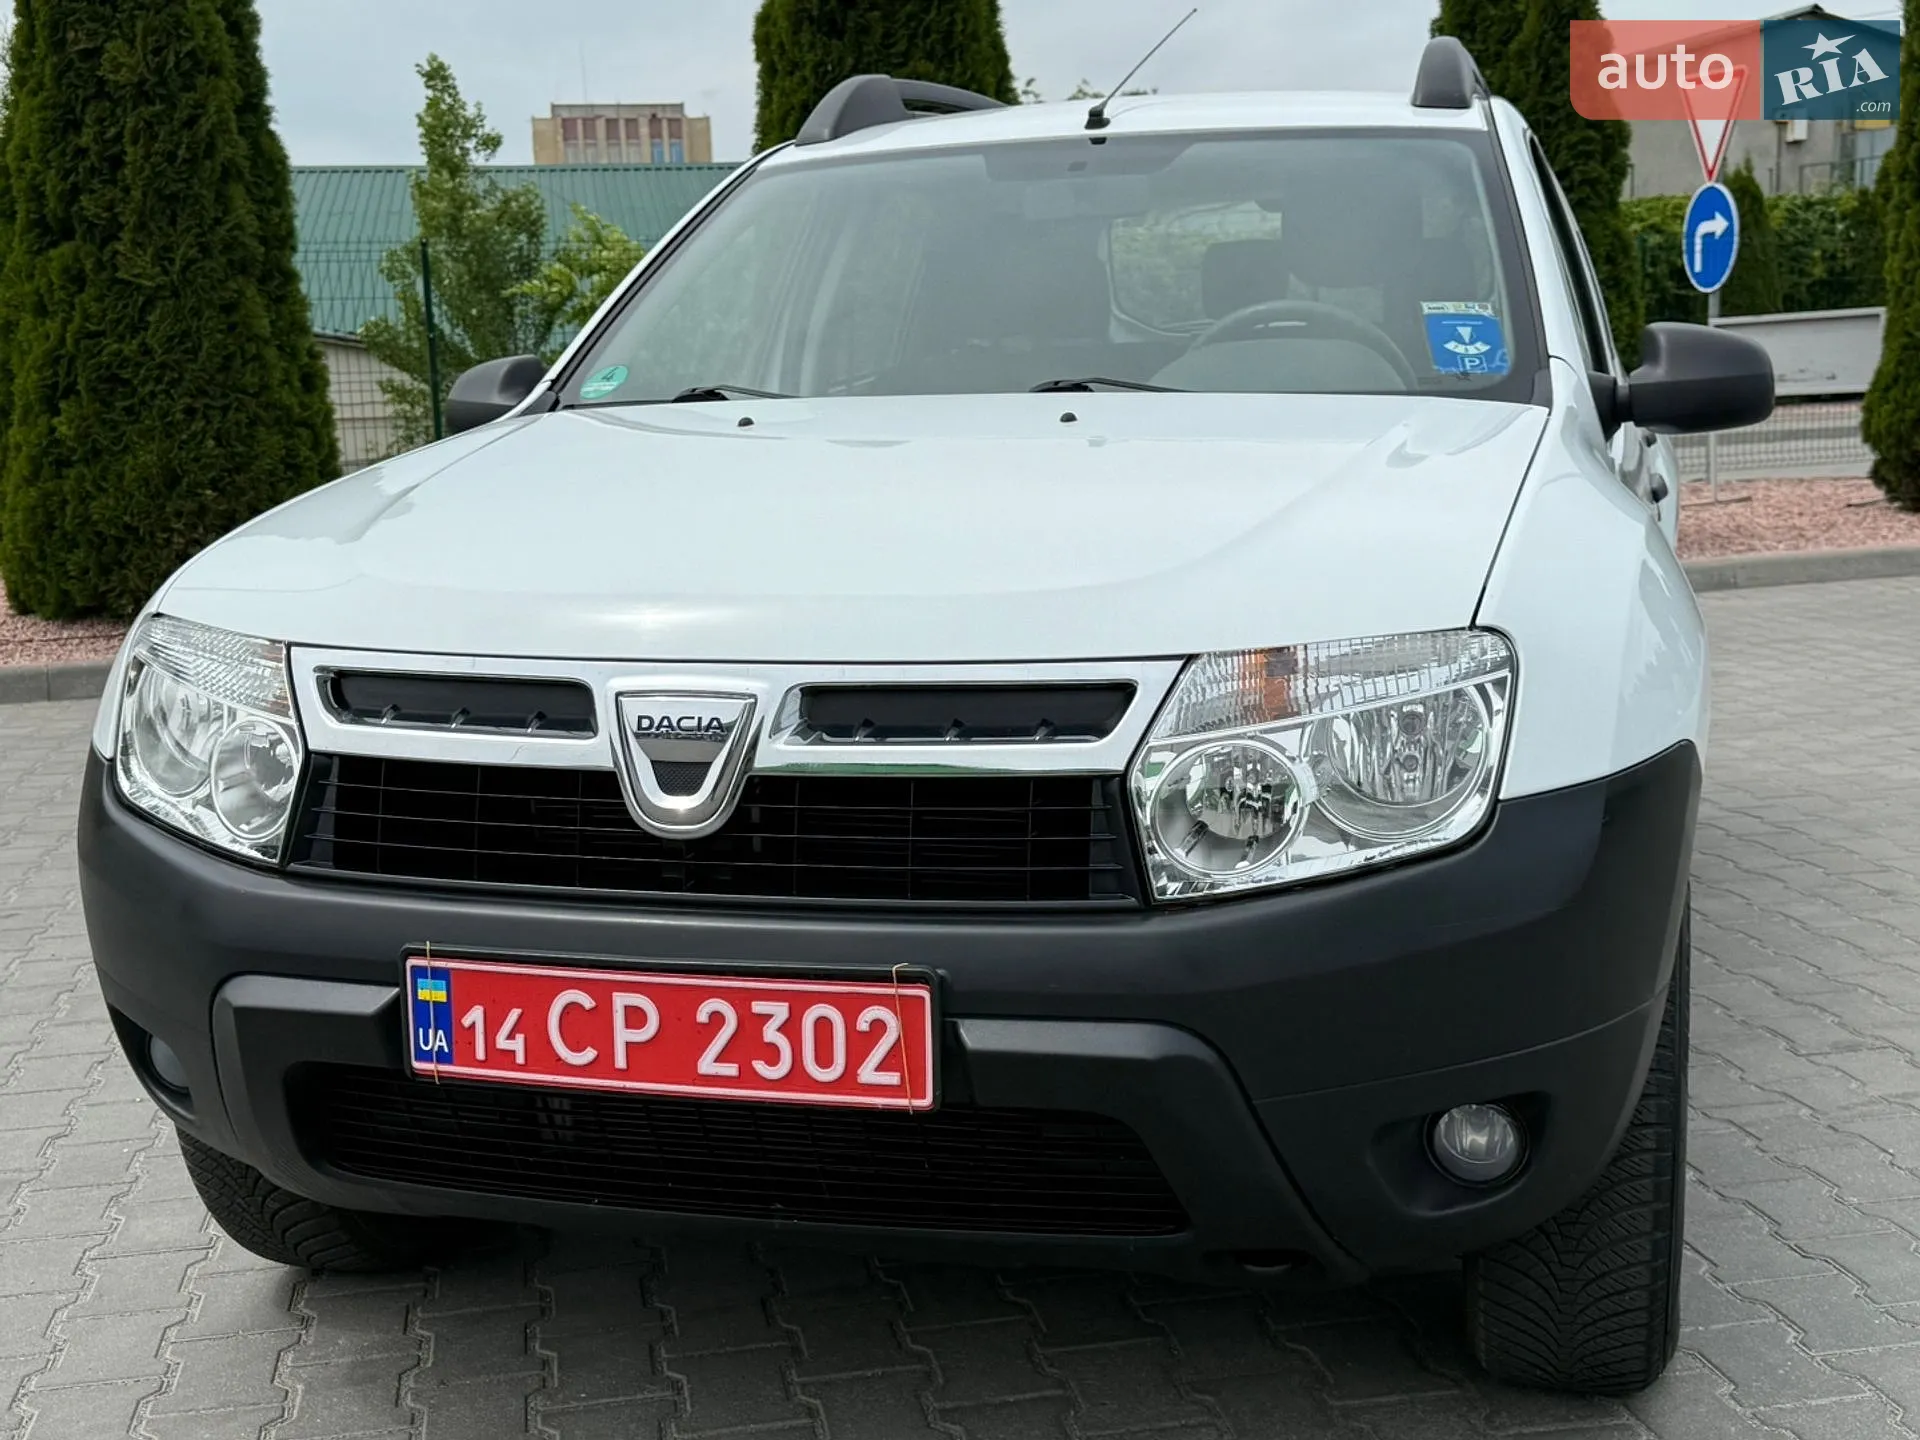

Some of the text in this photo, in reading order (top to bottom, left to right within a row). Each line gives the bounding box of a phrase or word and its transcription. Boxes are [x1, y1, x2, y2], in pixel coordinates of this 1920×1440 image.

[637, 714, 726, 733] DACIA
[418, 1027, 450, 1053] UA
[460, 989, 903, 1086] 14 CP 2302
